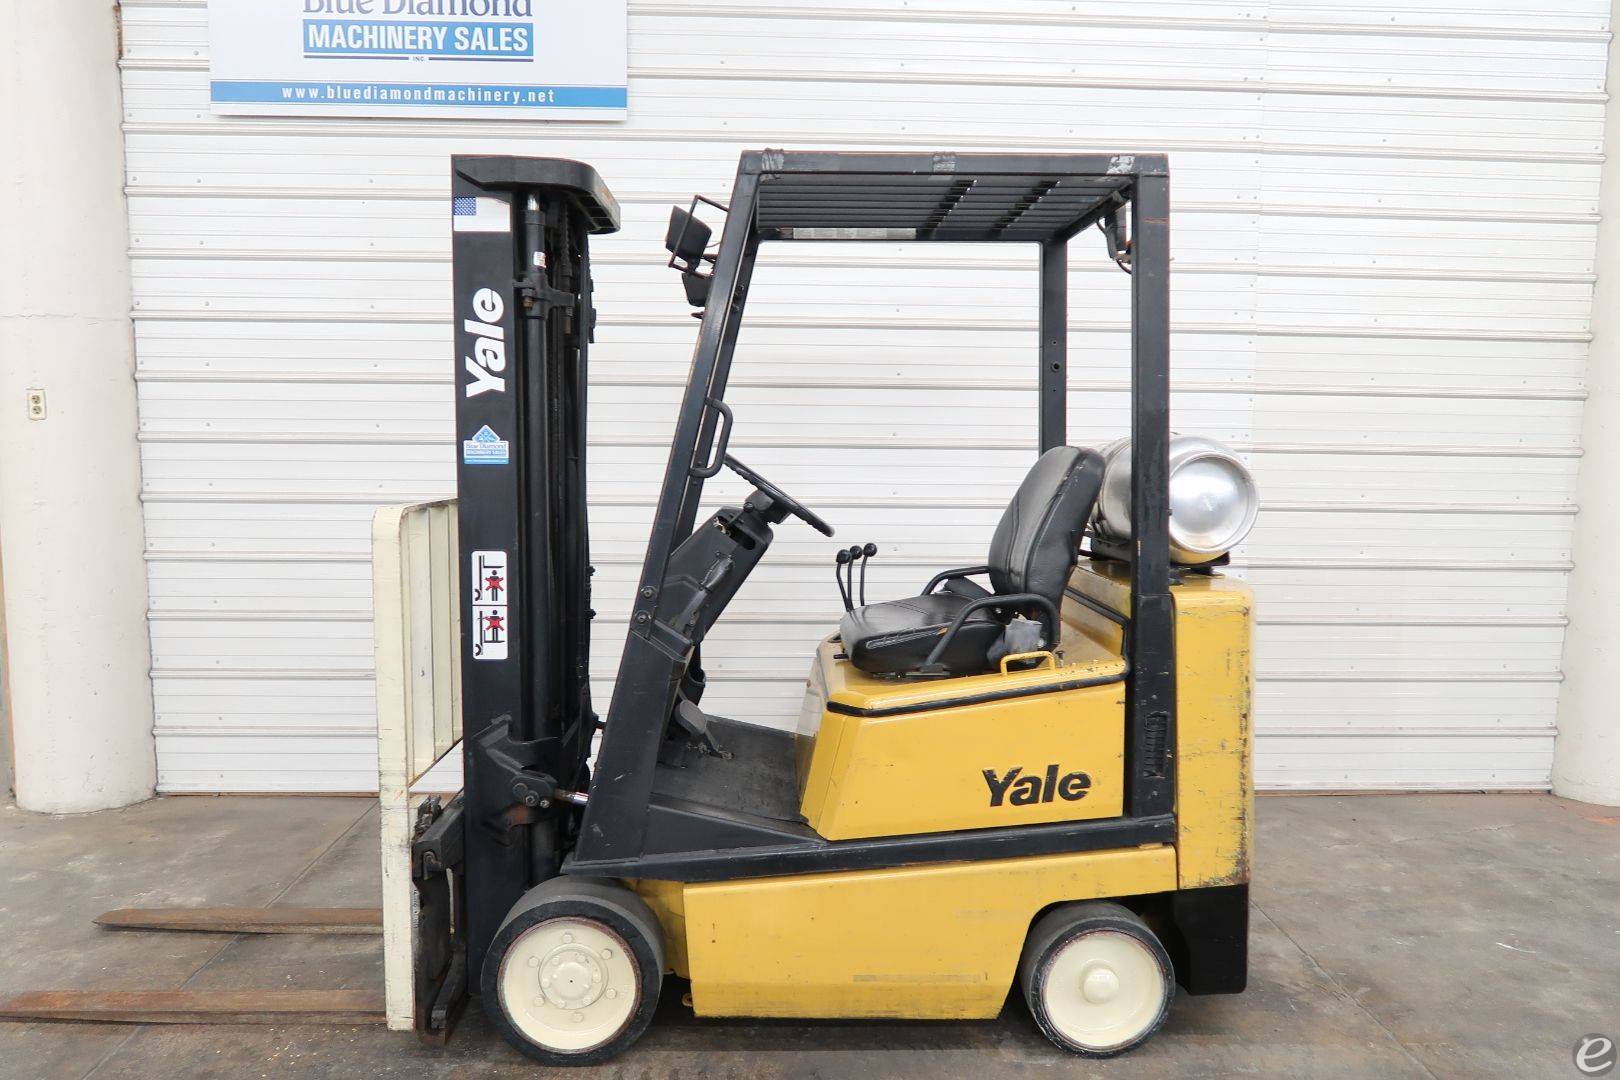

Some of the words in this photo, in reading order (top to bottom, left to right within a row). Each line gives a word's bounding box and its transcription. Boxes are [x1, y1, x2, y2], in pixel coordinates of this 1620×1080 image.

[382, 0, 533, 17] Diamond
[308, 24, 448, 50] MACHINERY
[454, 26, 528, 52] SALES
[282, 85, 554, 104] www.bluediamondmachinery.net
[464, 287, 506, 397] Yale
[982, 763, 1092, 807] Yale
